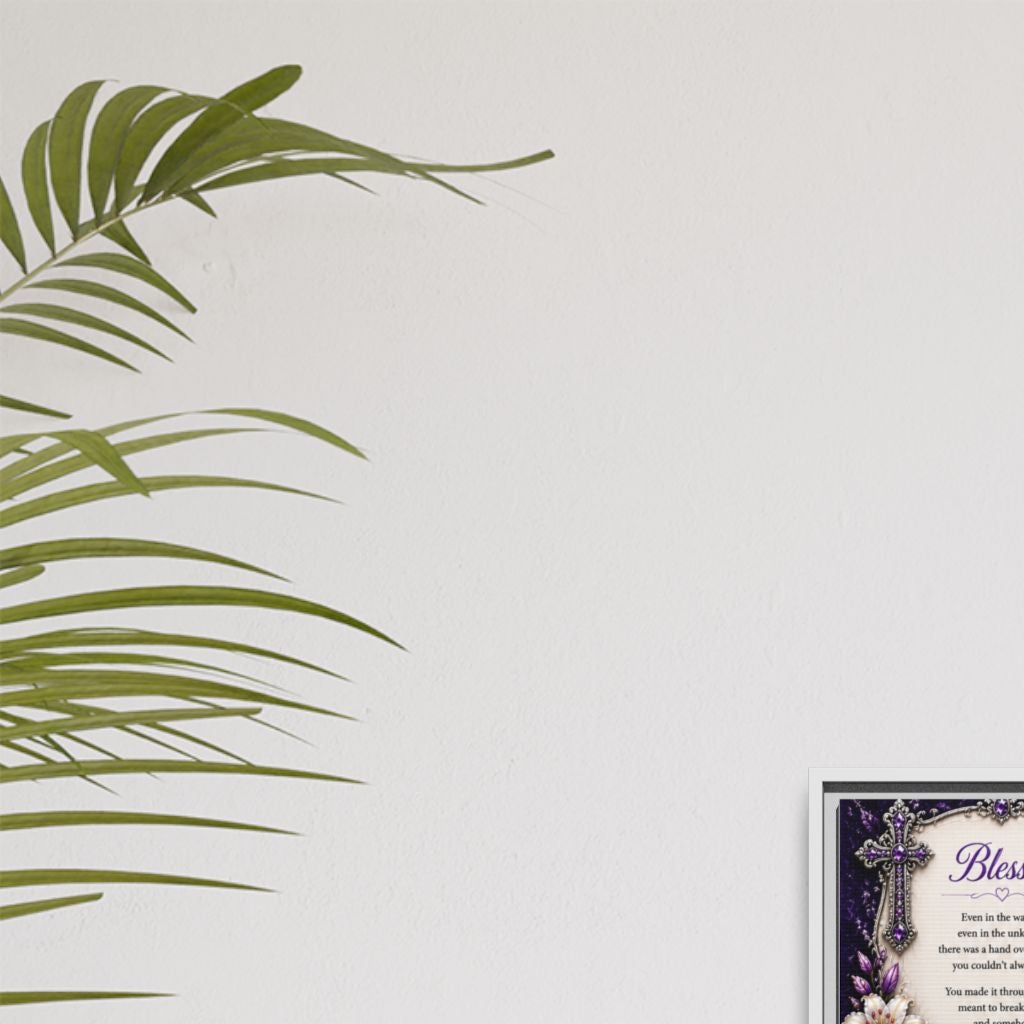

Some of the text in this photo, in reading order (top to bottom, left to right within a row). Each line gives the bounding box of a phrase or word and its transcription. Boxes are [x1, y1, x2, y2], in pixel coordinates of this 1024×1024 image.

[961, 912, 983, 922] Even
[985, 912, 995, 922] in
[997, 912, 1011, 922] the
[980, 929, 990, 938] in
[991, 929, 1006, 938] the
[938, 944, 961, 954] there
[963, 946, 979, 954] was
[988, 944, 1011, 954] hand
[952, 963, 969, 973] you
[971, 960, 1007, 970] couldn't
[945, 987, 962, 996] You
[964, 987, 989, 996] made
[991, 987, 998, 996] it
[958, 1004, 986, 1012] meant
[988, 1004, 998, 1012] to
[999, 1002, 1024, 1012] break
